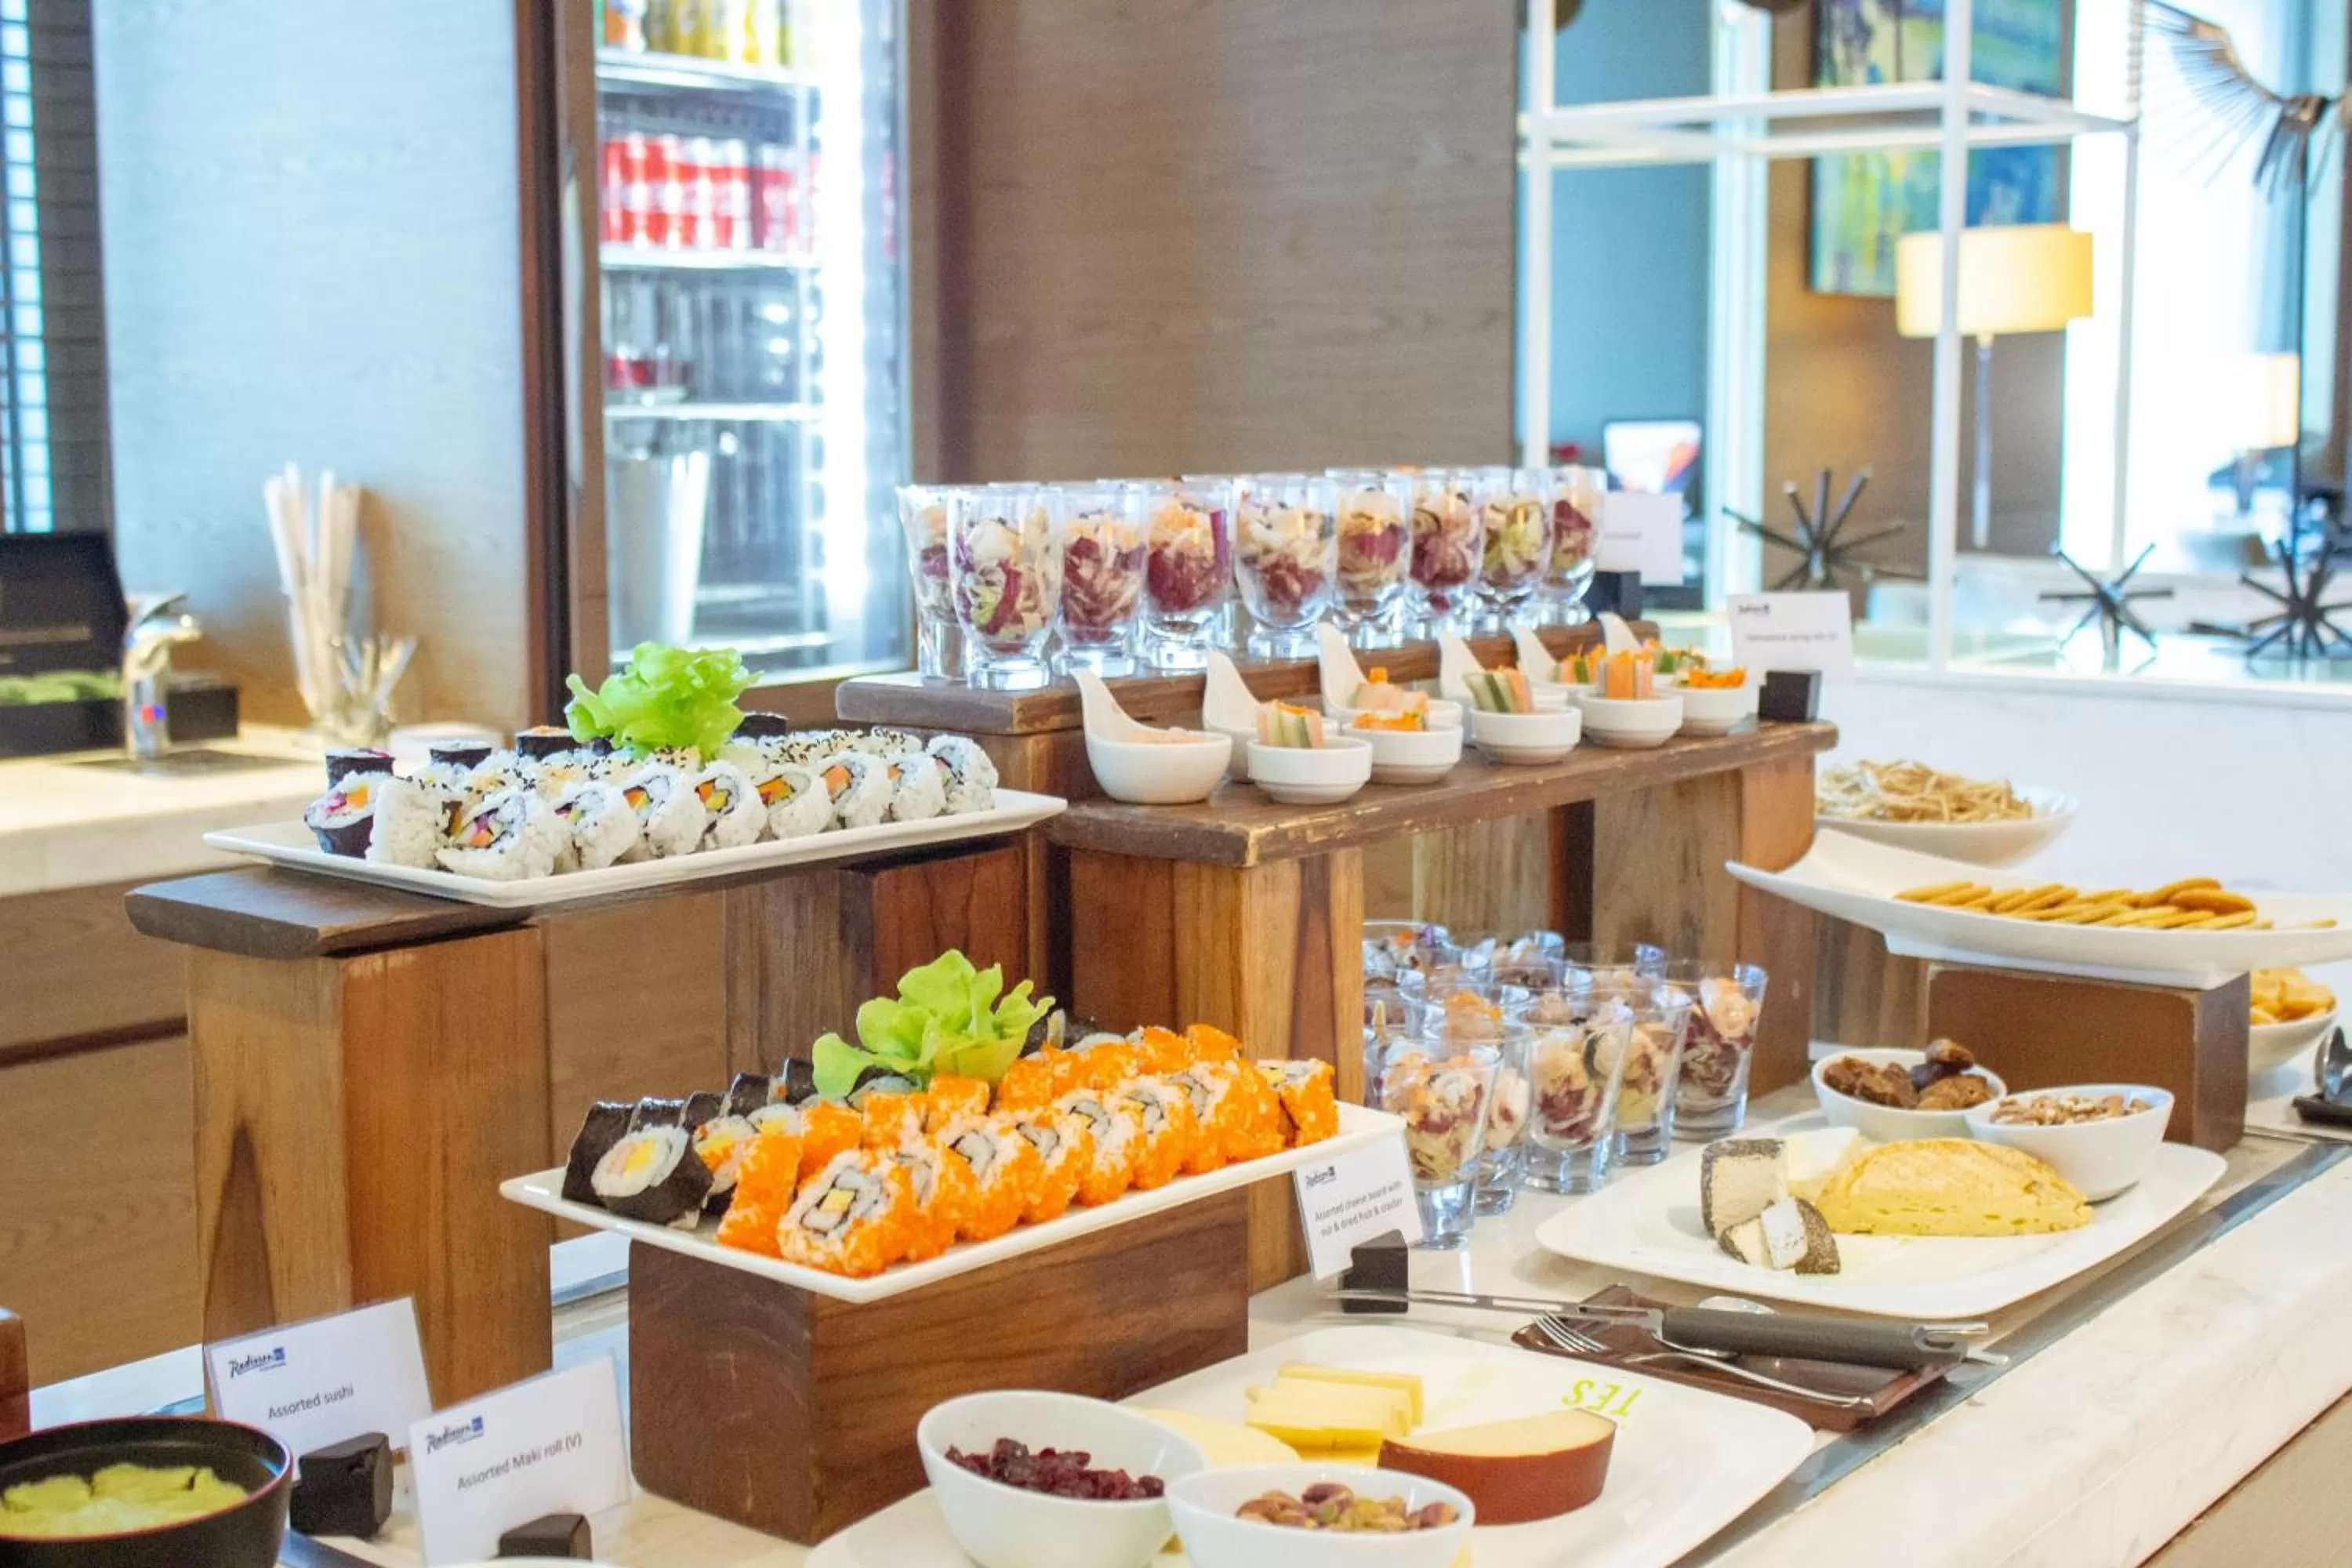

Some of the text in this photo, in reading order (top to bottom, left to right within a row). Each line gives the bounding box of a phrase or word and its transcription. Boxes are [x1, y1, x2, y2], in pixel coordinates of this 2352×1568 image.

[228, 1353, 273, 1378] Radisson
[268, 1382, 354, 1420] Assorted sushi
[457, 1431, 583, 1490] Assorted Maki roll (V)
